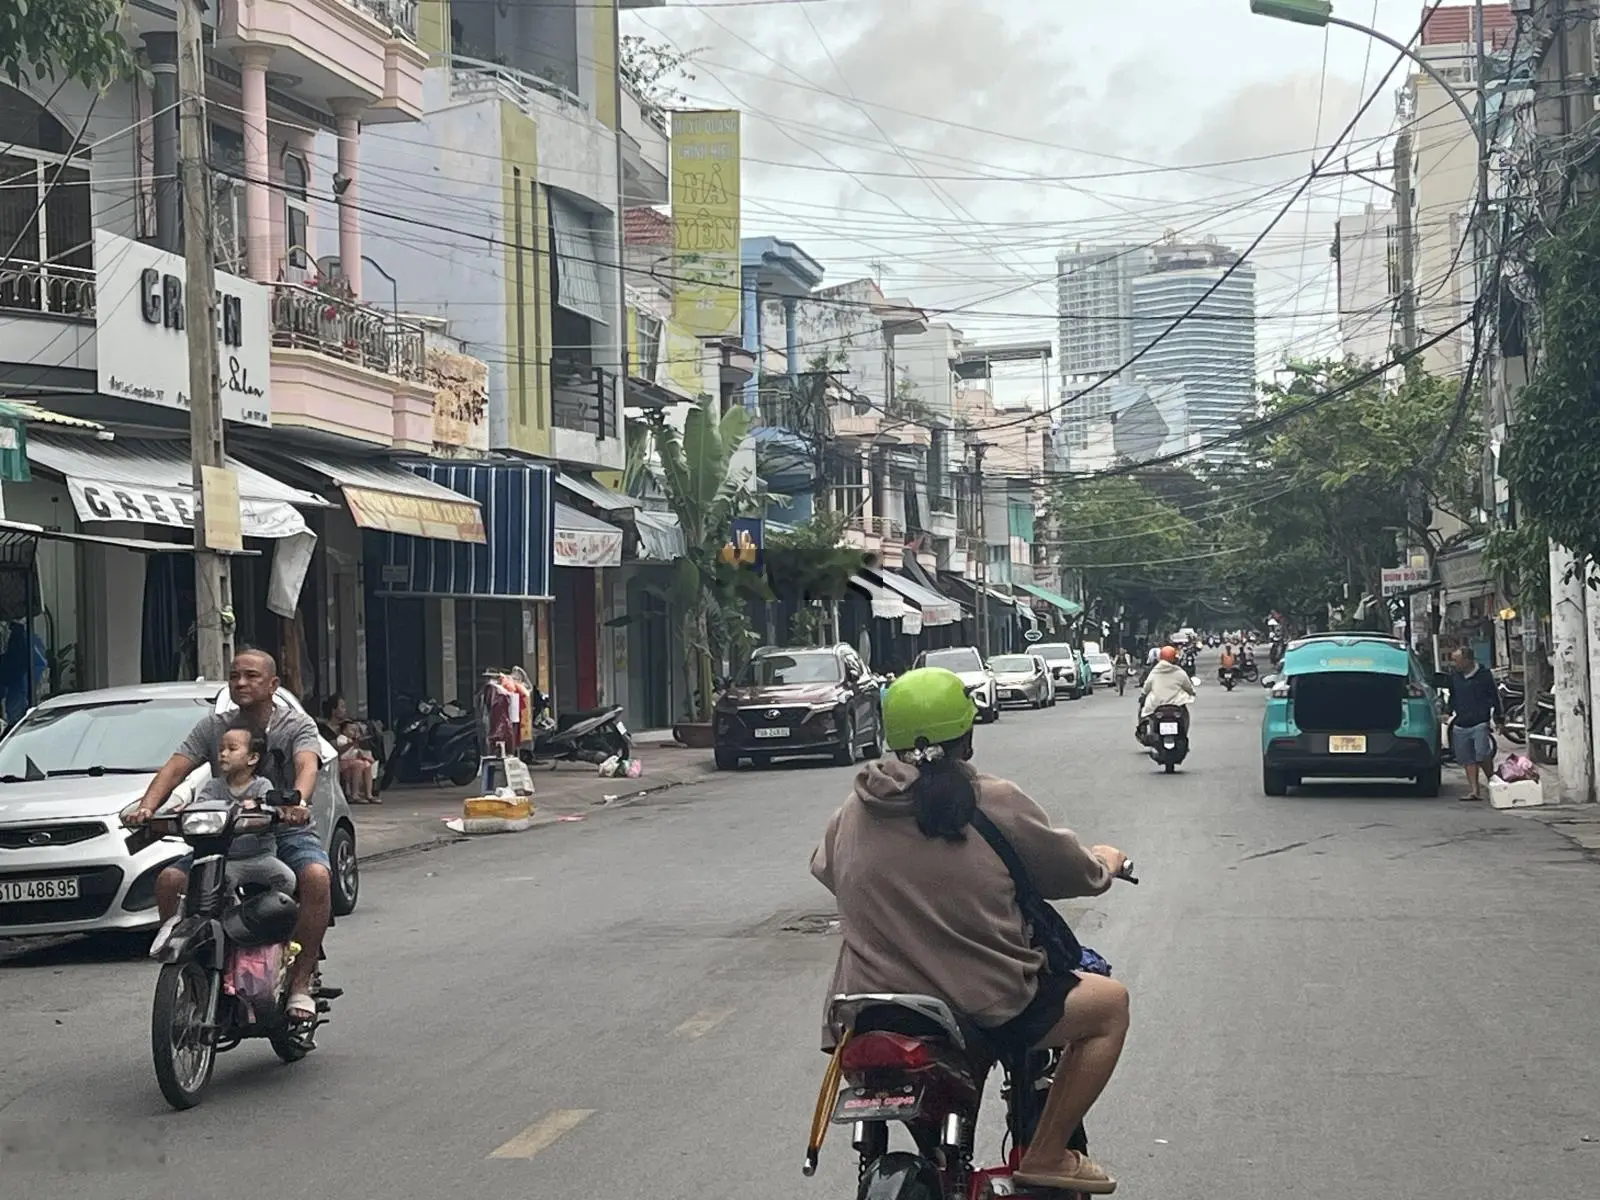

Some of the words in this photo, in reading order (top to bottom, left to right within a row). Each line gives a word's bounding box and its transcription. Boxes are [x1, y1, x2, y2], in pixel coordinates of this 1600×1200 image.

[674, 208, 738, 250] YÊN
[141, 268, 242, 347] GRN
[84, 487, 195, 525] GREE
[0, 883, 22, 901] 1D
